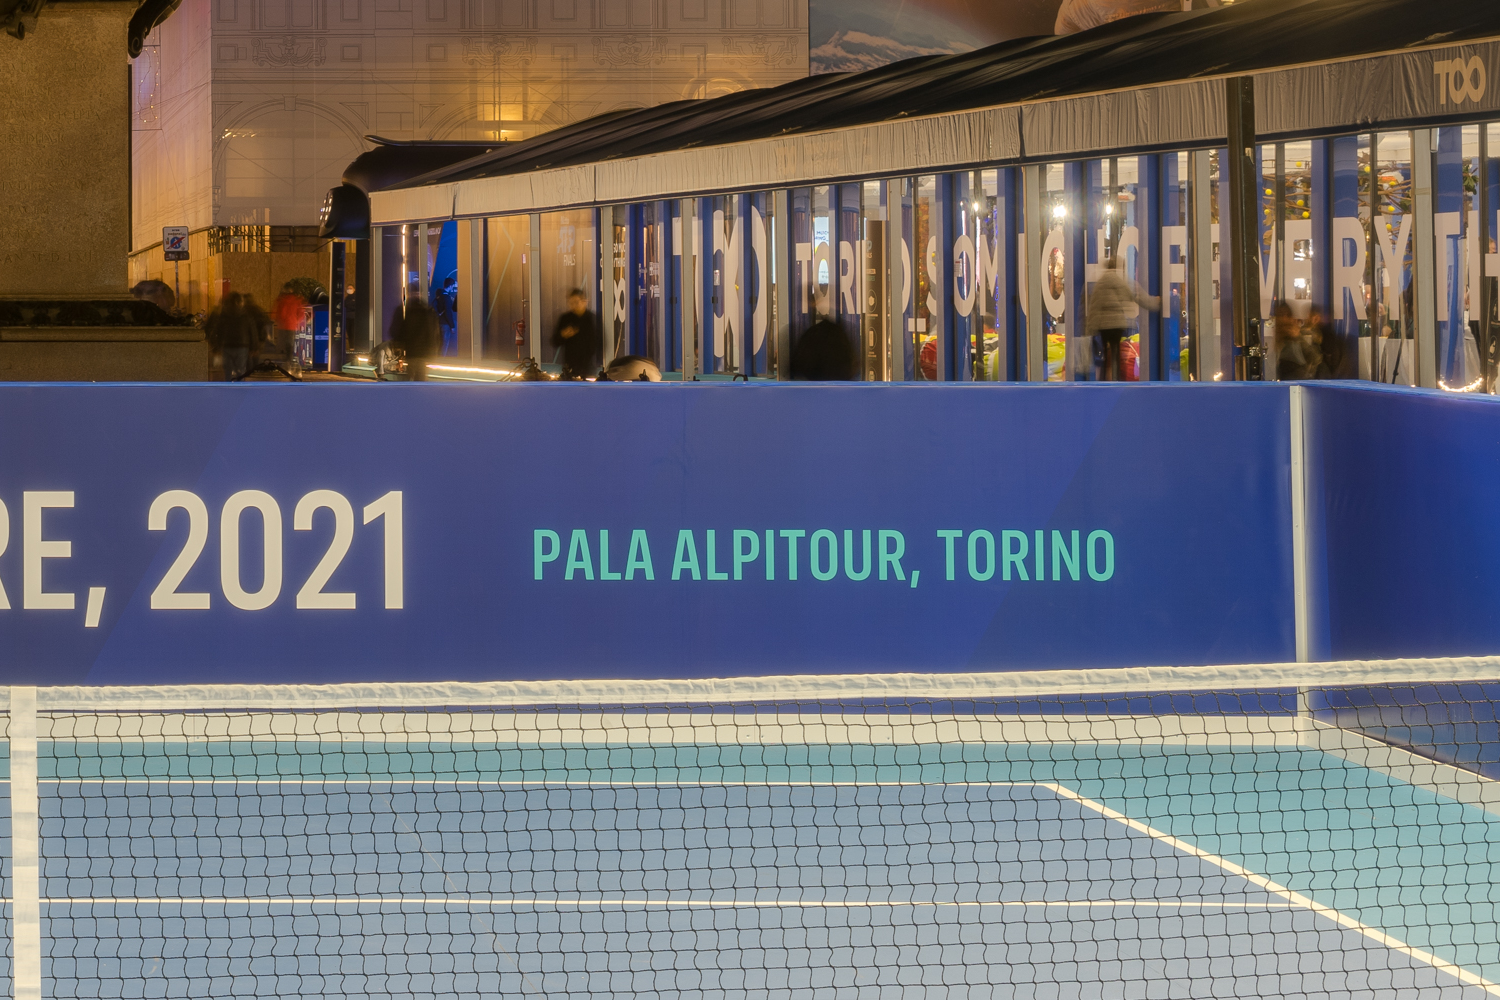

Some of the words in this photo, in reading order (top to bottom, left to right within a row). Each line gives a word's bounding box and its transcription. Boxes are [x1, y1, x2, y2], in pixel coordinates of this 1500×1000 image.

[1433, 55, 1487, 105] TOO
[146, 489, 405, 611] 2021
[532, 528, 656, 581] PALA
[671, 528, 921, 589] ALPITOUR,
[936, 528, 1116, 582] TORINO
